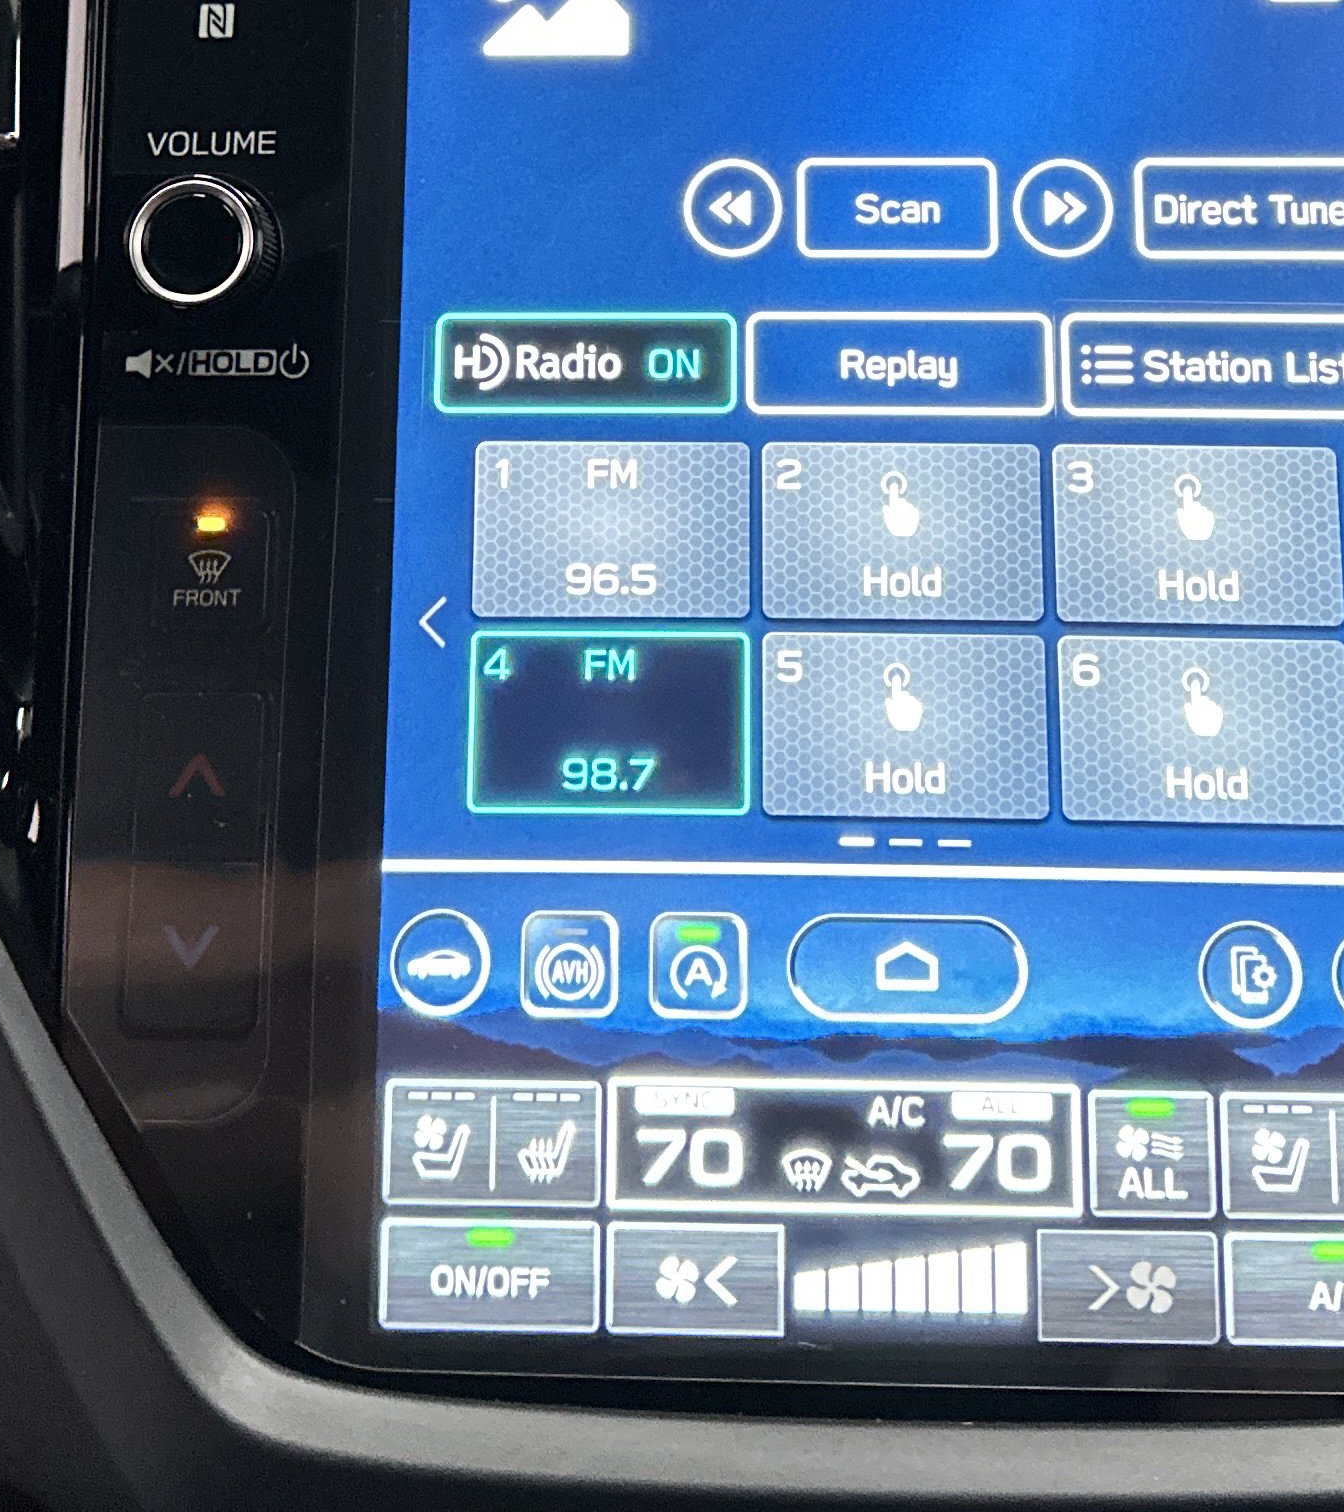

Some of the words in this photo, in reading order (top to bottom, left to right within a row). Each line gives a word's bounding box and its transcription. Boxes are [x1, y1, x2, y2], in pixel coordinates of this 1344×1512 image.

[147, 130, 278, 156] VOLUME
[854, 193, 942, 227] Scan
[1153, 193, 1258, 227] Direct
[646, 347, 702, 380] ON
[839, 348, 958, 390] Replay
[1144, 349, 1272, 385] Station
[494, 459, 510, 489] 1
[586, 459, 639, 487] FM
[775, 459, 802, 490] 2
[1066, 461, 1094, 493] 3
[564, 562, 656, 596] 96.5
[862, 566, 943, 600] Hold
[1157, 569, 1240, 604] Hold
[173, 589, 241, 607] FRONT
[482, 649, 511, 682] 4
[583, 650, 637, 680] FM
[776, 650, 804, 682] 5
[1070, 654, 1100, 686] 6
[561, 759, 655, 794] 98.7
[864, 761, 946, 796] Hold
[1165, 767, 1250, 802] Hold
[551, 959, 589, 984] AVH
[868, 1096, 926, 1128] A/C
[636, 1128, 744, 1187] 70
[943, 1134, 1054, 1193] 70
[1118, 1167, 1188, 1201] ALL
[429, 1265, 551, 1299] ON/OFF
